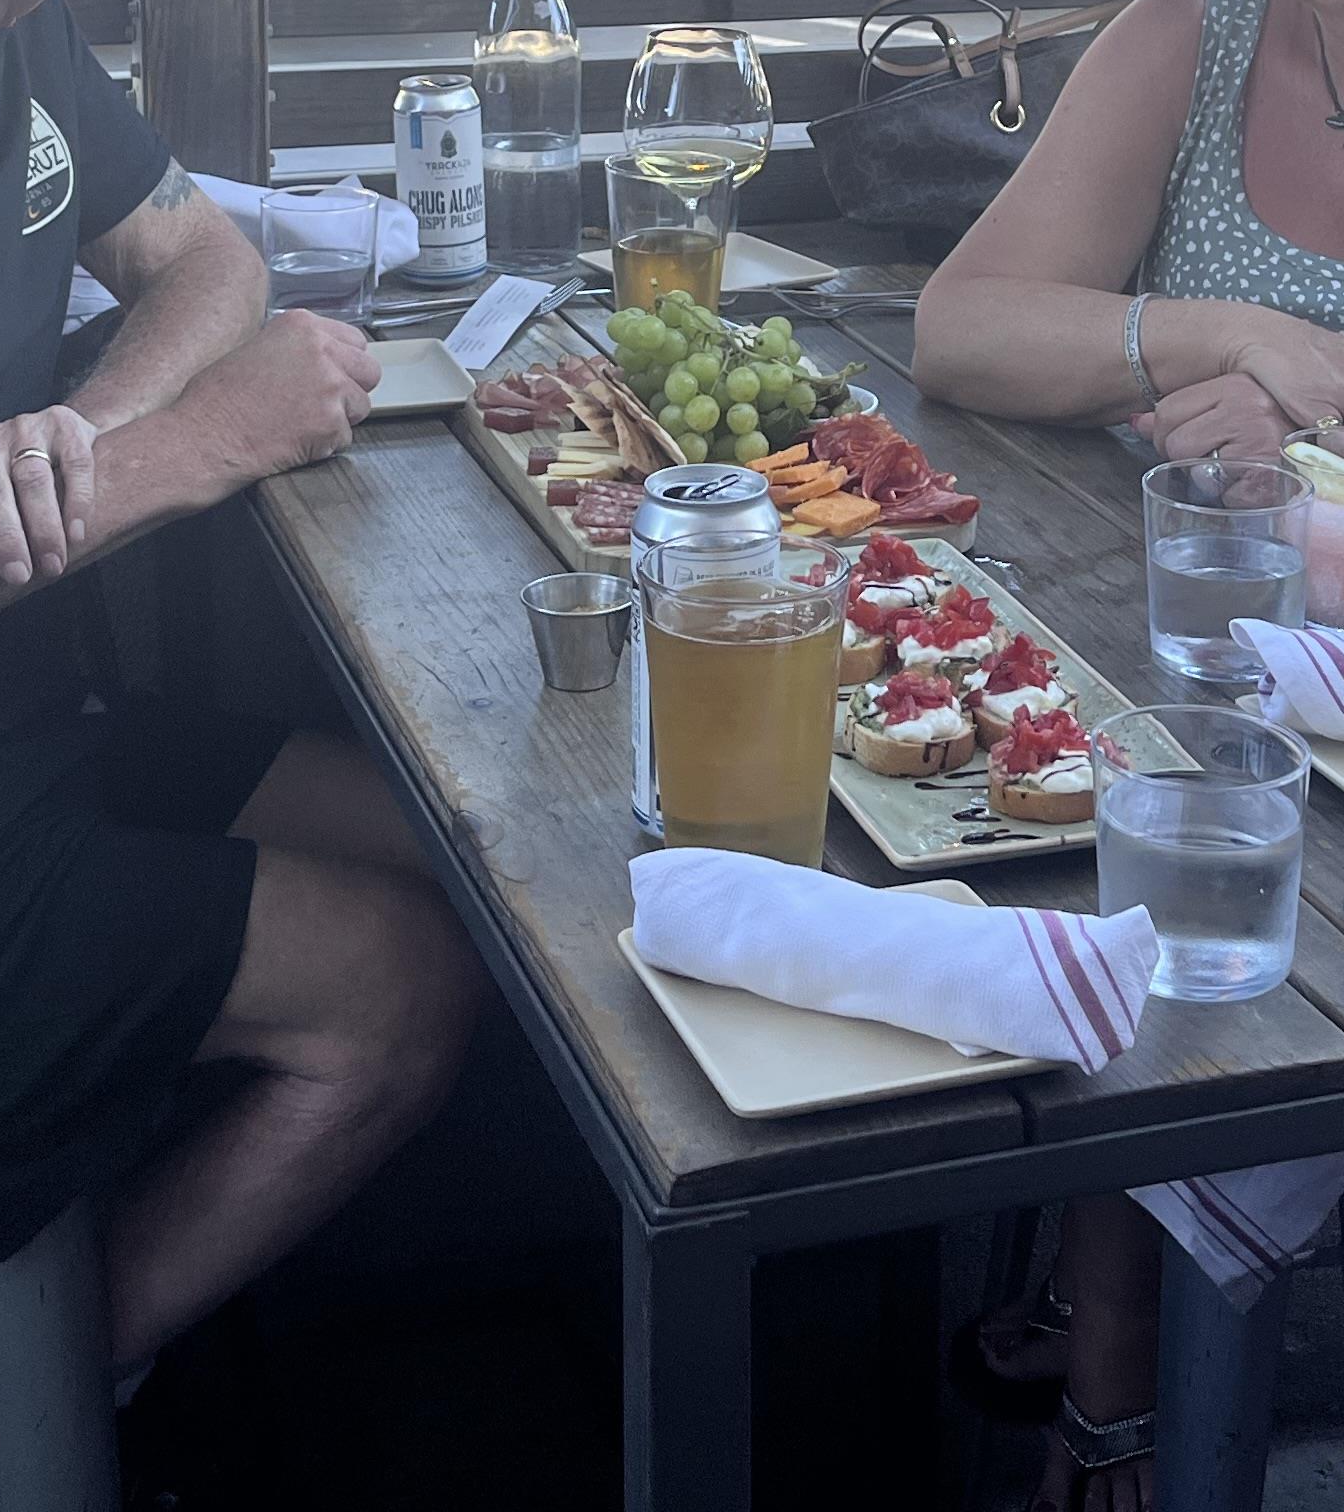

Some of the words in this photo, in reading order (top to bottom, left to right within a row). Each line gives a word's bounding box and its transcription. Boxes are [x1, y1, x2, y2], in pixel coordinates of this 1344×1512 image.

[26, 143, 64, 182] RUZ
[408, 189, 446, 215] CHUG
[417, 215, 447, 230] RISPY
